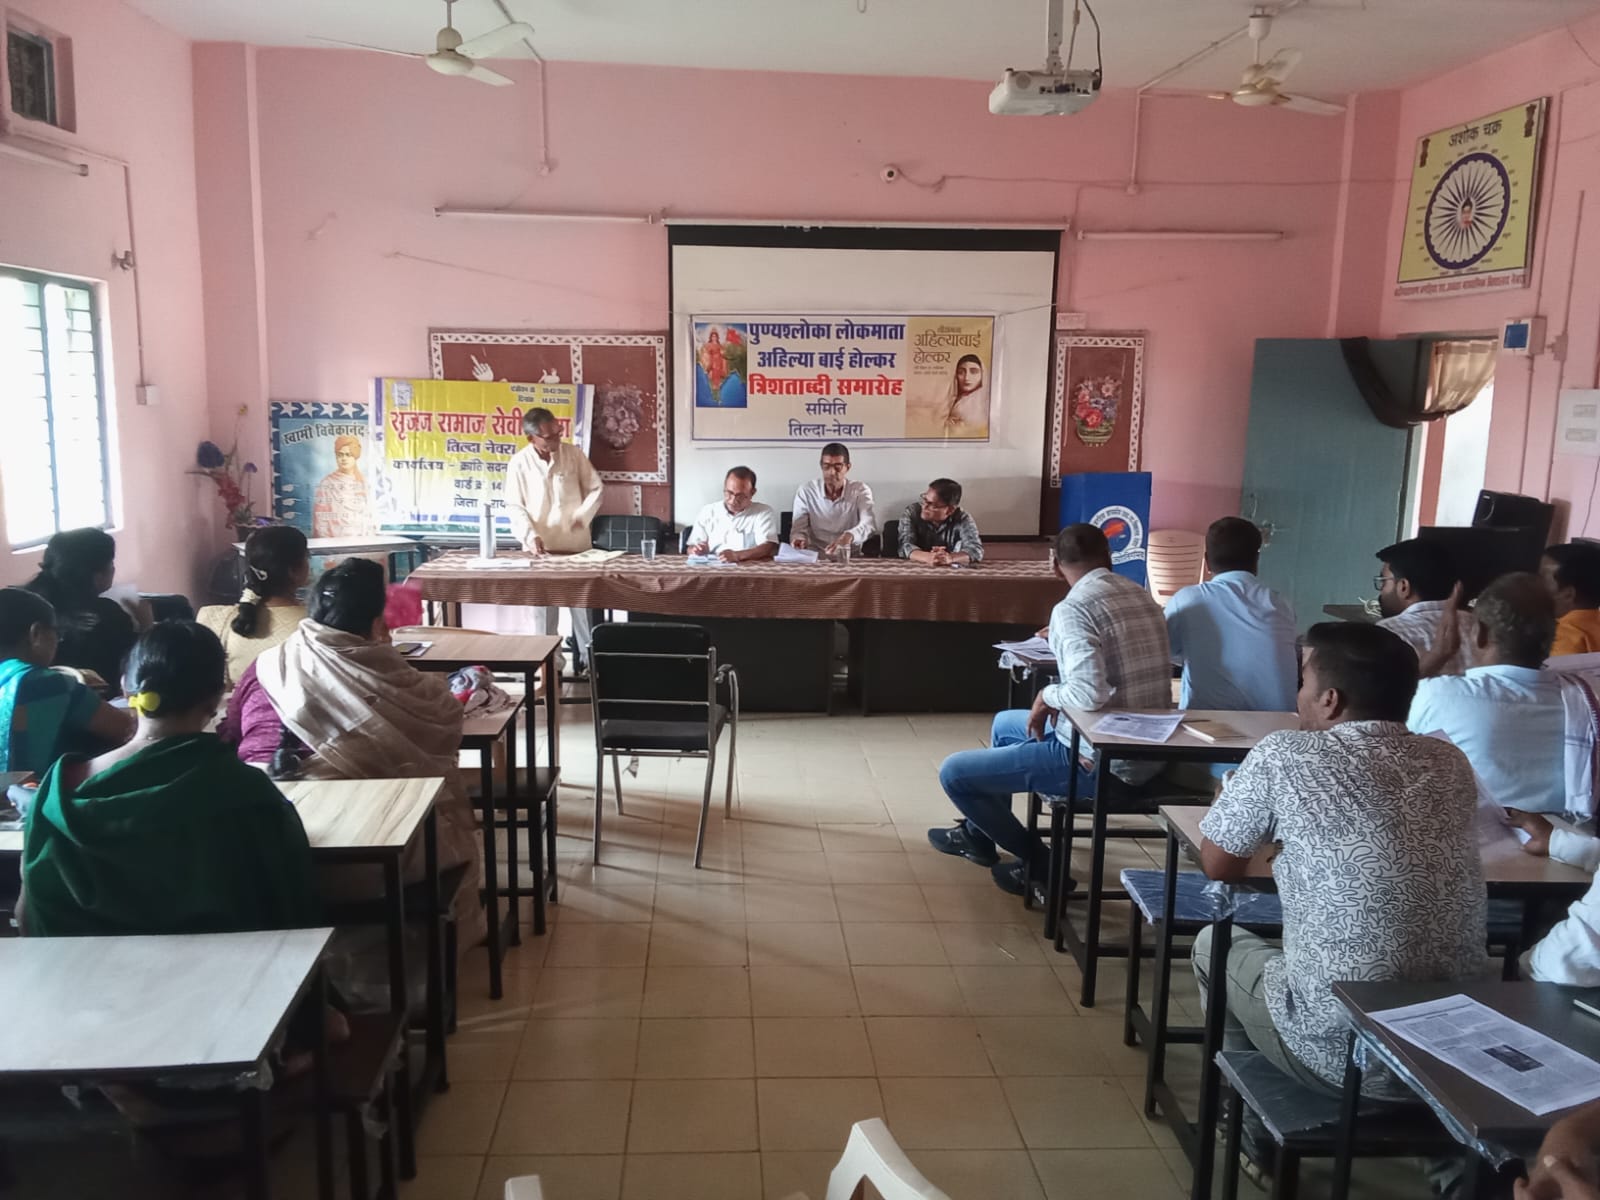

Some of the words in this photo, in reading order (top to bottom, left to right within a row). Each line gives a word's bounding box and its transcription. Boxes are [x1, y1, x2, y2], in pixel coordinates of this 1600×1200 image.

[1449, 124, 1480, 147] अशोक
[1483, 119, 1503, 136] चक्र
[749, 318, 832, 345] पुण्यश्लोका
[835, 319, 906, 340] लोकमाता
[913, 329, 982, 348] अहिल्याबाई
[757, 347, 815, 368] अहिल्या
[818, 347, 845, 370] बाई
[848, 347, 896, 369] होल्कर
[913, 347, 951, 364] होल्कर
[749, 373, 832, 395] त्रिशताब्दी
[837, 374, 904, 396] समारोह
[805, 397, 847, 415] समिति
[283, 425, 314, 444] स्वामी
[316, 422, 365, 438] विवेकानंद
[447, 438, 480, 453] तिल्दा
[485, 440, 517, 455] नेवरा
[454, 494, 478, 507] जिला
